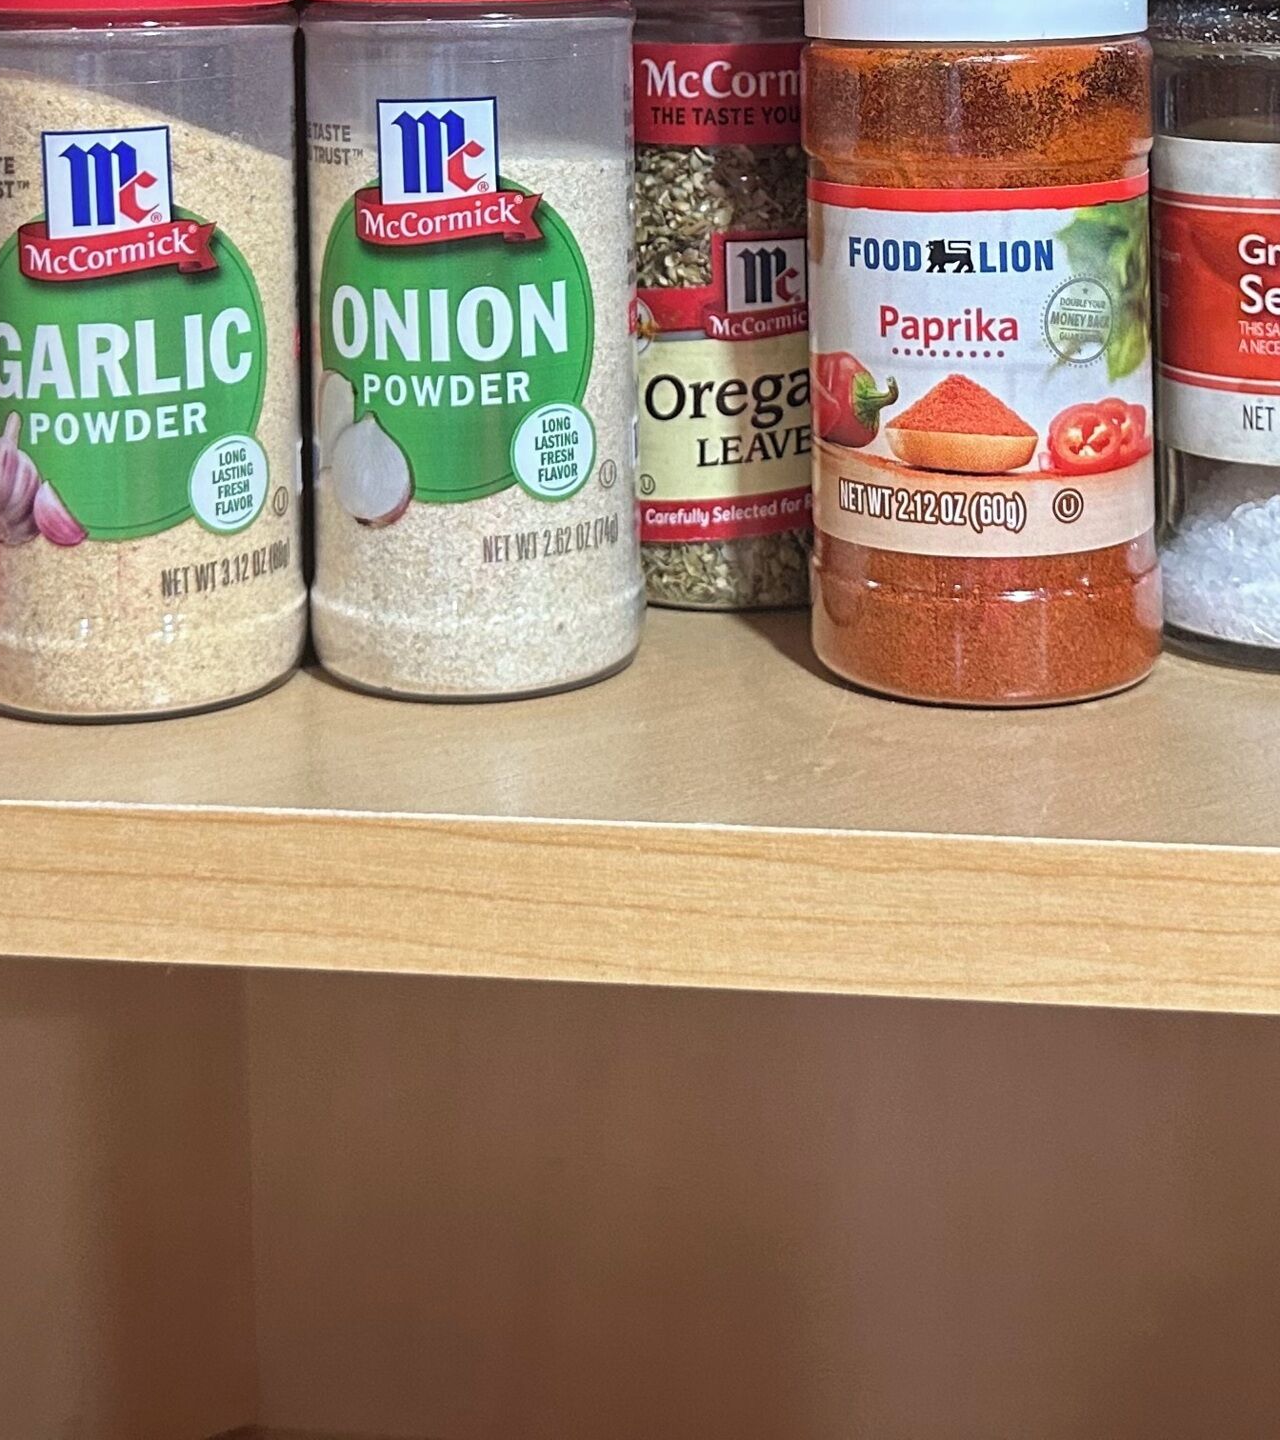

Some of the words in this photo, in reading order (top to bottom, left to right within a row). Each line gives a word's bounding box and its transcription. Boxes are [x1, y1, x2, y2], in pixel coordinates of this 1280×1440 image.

[651, 106, 686, 126] THE
[692, 106, 755, 126] TASTE
[762, 105, 801, 126] YOU
[313, 122, 351, 142] TASTE
[360, 202, 519, 240] McCormick
[26, 233, 196, 274] McCormick
[848, 236, 922, 272] FOOD
[979, 238, 1054, 273] LION
[331, 280, 569, 362] ONION
[880, 305, 1019, 349] Paprika
[1050, 311, 1086, 327] MONEY
[1238, 320, 1263, 336] THIS
[1238, 342, 1249, 353] A
[363, 371, 531, 407] POWDER
[30, 401, 208, 445] POWDER
[542, 416, 571, 433] LONG
[1242, 404, 1275, 431] NET
[534, 431, 579, 451] LASTING
[219, 448, 247, 467] LONG
[540, 447, 574, 466] FRESH
[212, 462, 254, 484] LASTING
[538, 463, 578, 482] FLAVOR
[218, 479, 250, 499] FRESH
[215, 494, 253, 516] FLAVOR
[645, 507, 710, 527] Carefully
[712, 500, 778, 523] Selected
[780, 496, 801, 514] for
[839, 477, 866, 512] NET
[867, 482, 893, 519] WT
[895, 488, 939, 524] 2.12
[940, 491, 967, 525] OZ
[969, 491, 1026, 533] (60g)
[483, 534, 511, 563] NET
[515, 531, 538, 561] WT
[543, 526, 572, 557] 2.62
[576, 521, 591, 550] OZ
[161, 566, 189, 597] NET
[195, 560, 217, 592] WT
[221, 553, 249, 587] 3.12
[252, 547, 267, 577] OZ
